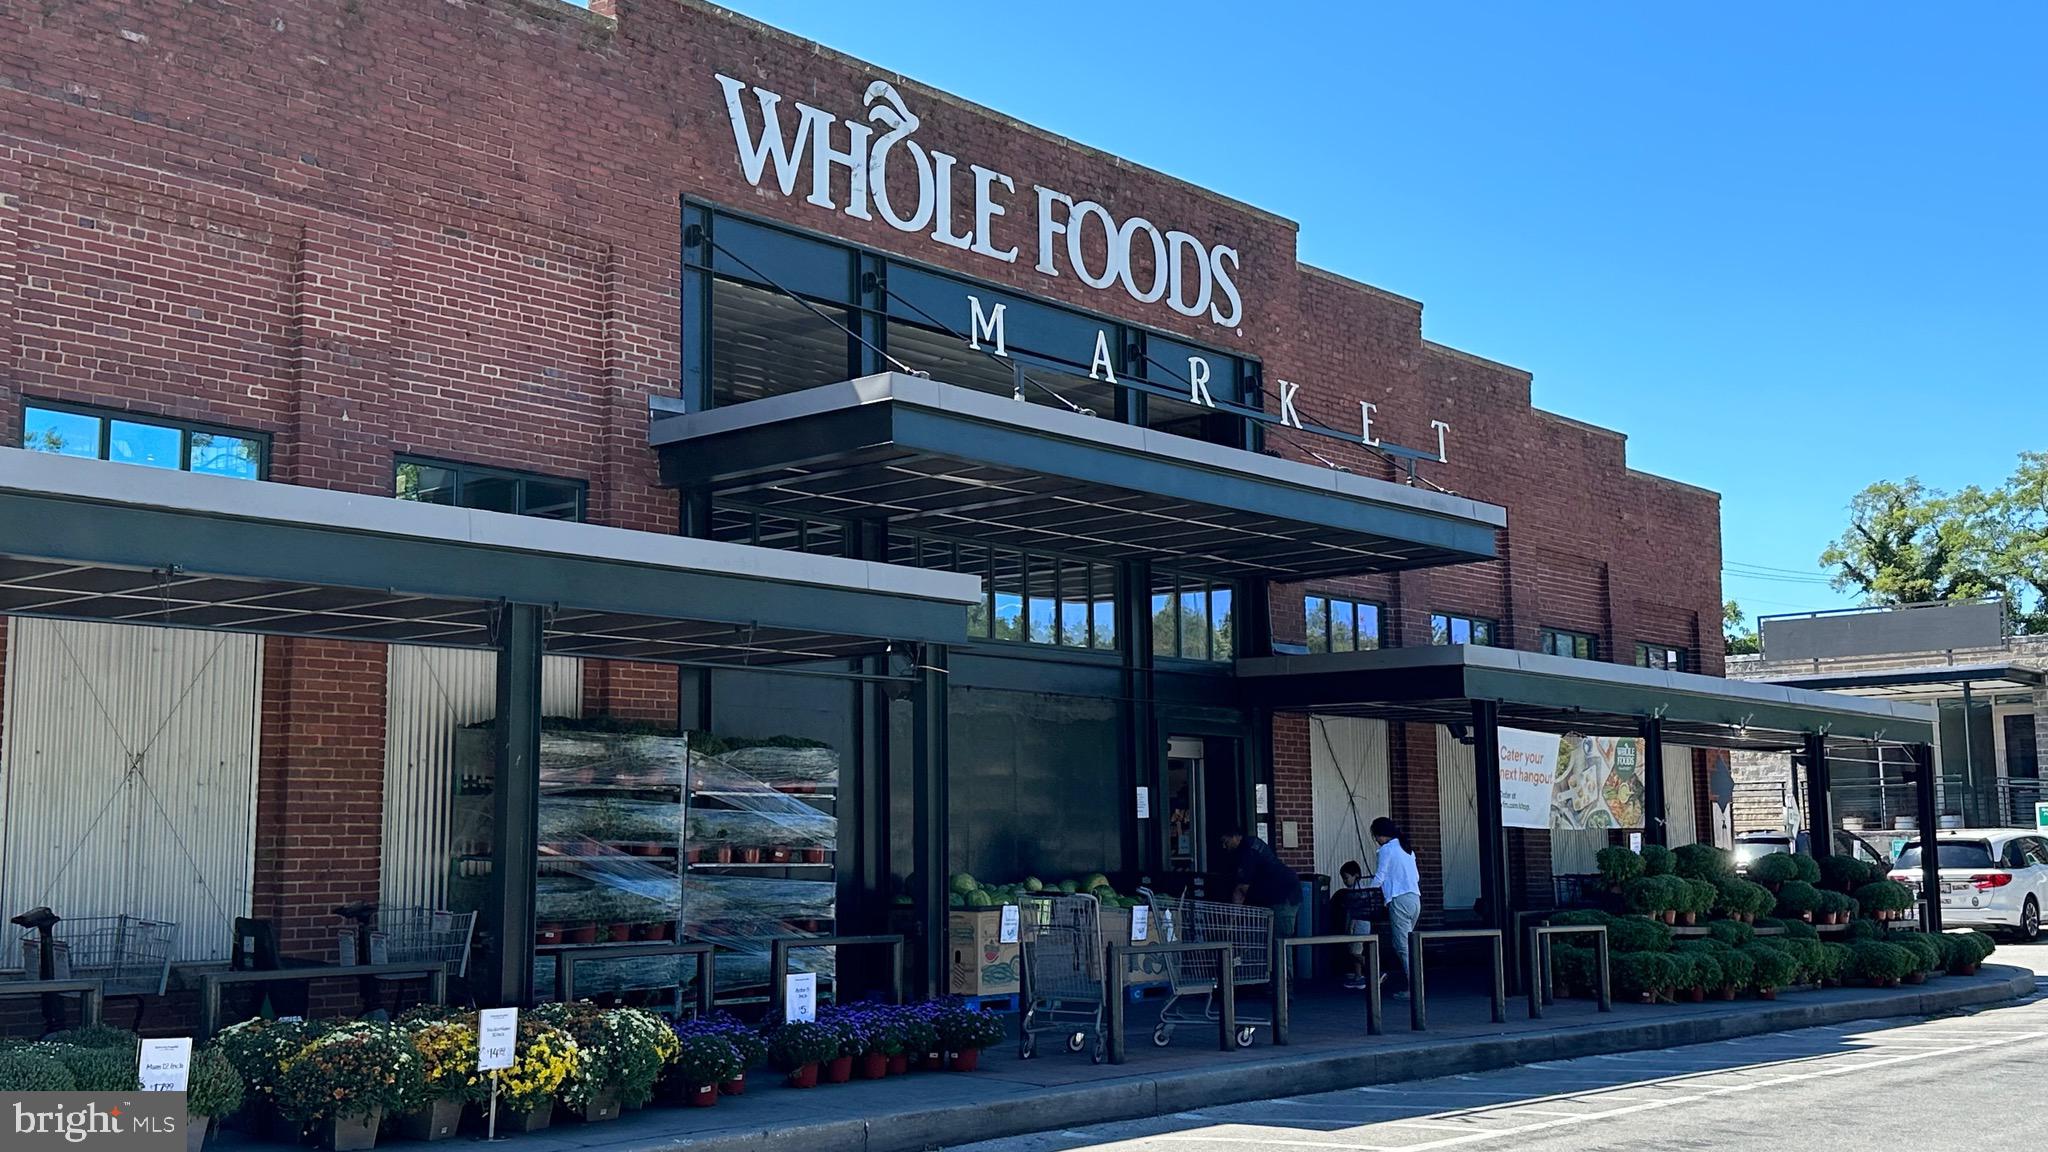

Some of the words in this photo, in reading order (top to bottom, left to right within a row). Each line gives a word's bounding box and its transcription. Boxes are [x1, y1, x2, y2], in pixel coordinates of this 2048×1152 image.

[714, 73, 1019, 264] WHOLE
[1032, 184, 1242, 329] FOODS
[1500, 745, 1524, 762] Cater
[1525, 752, 1544, 766] your
[1500, 768, 1517, 781] next
